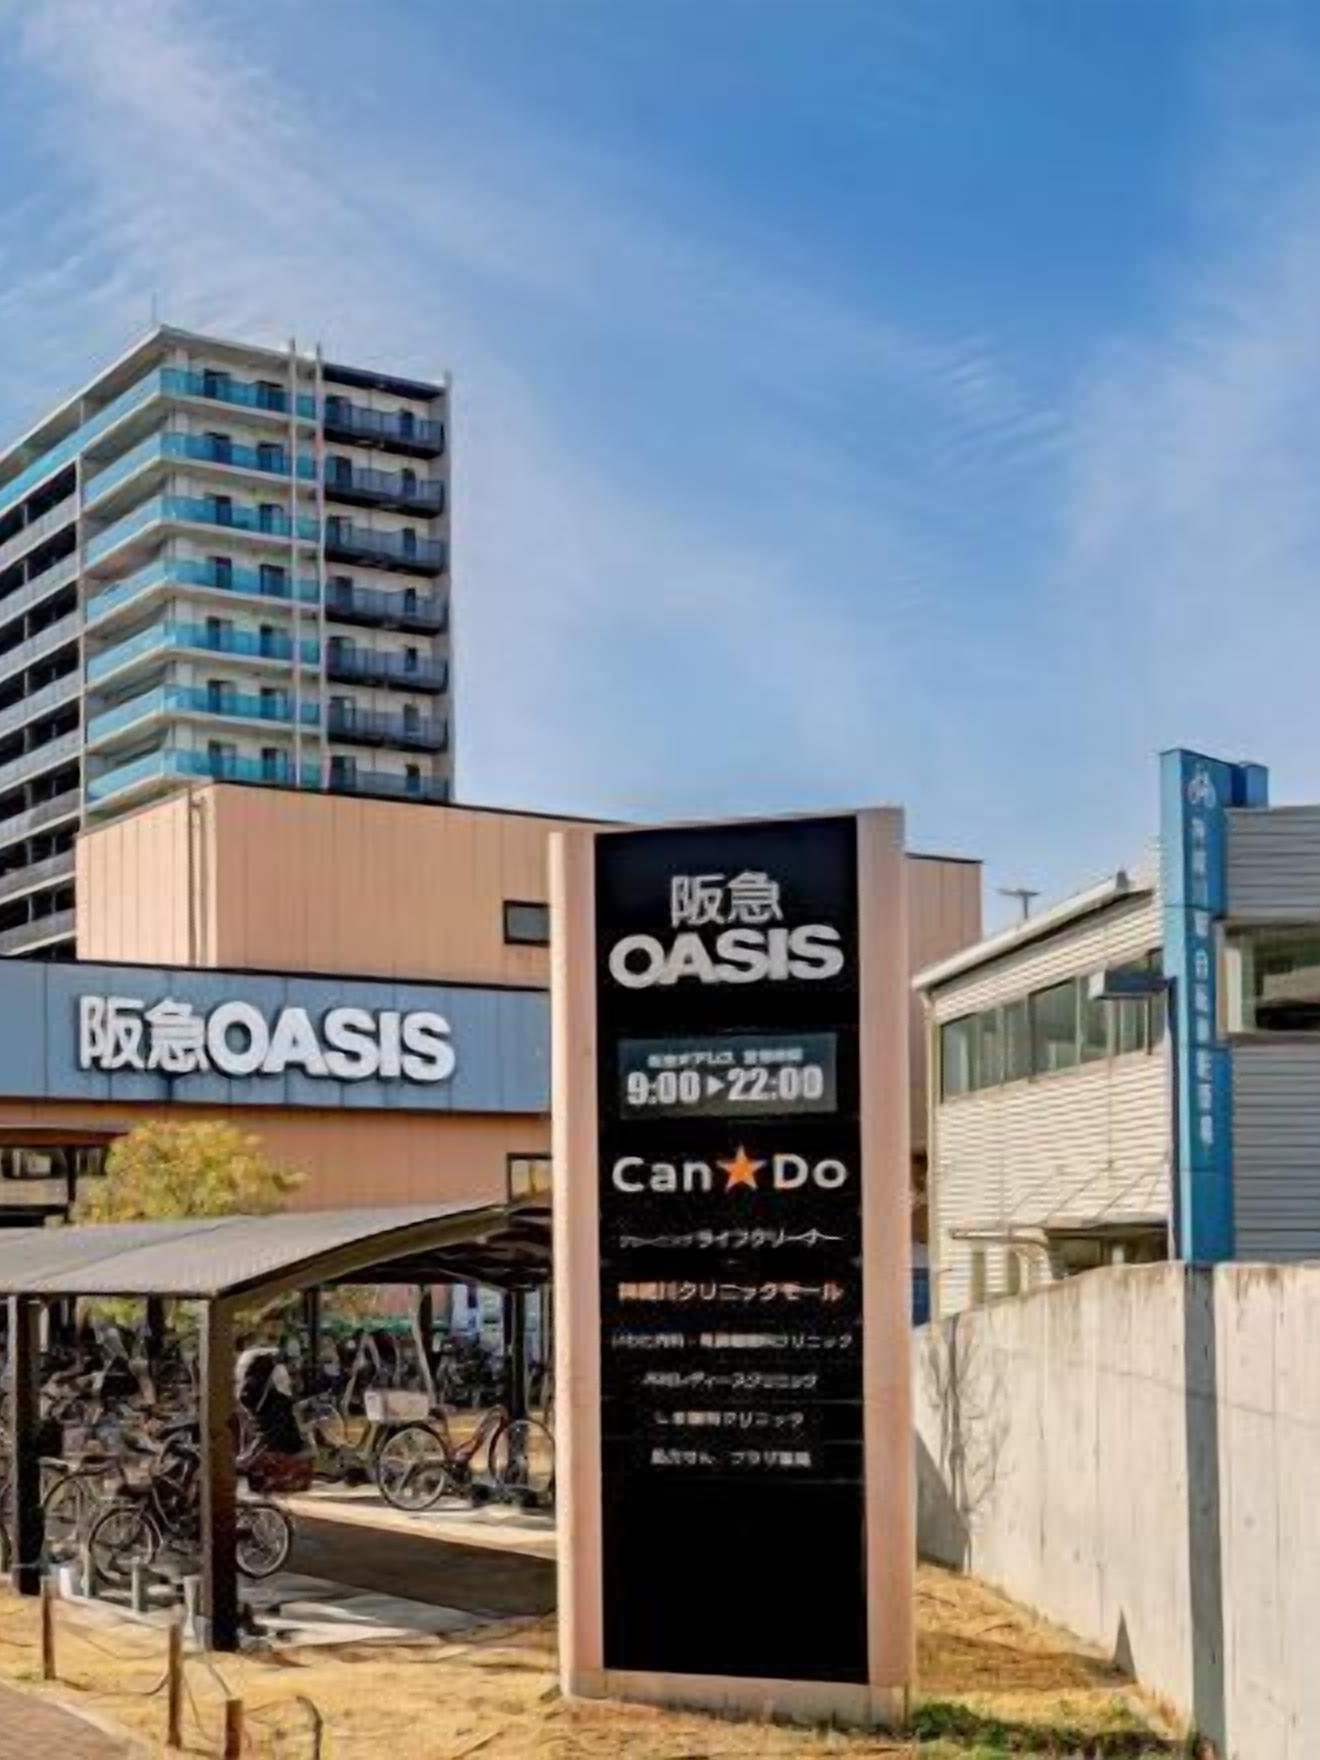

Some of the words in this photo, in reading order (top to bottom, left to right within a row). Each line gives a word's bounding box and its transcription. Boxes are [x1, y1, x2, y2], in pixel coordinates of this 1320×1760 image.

[671, 870, 784, 927] 阪急
[609, 924, 844, 989] OASIS
[612, 1157, 713, 1192] Can
[773, 1154, 848, 1188] Do
